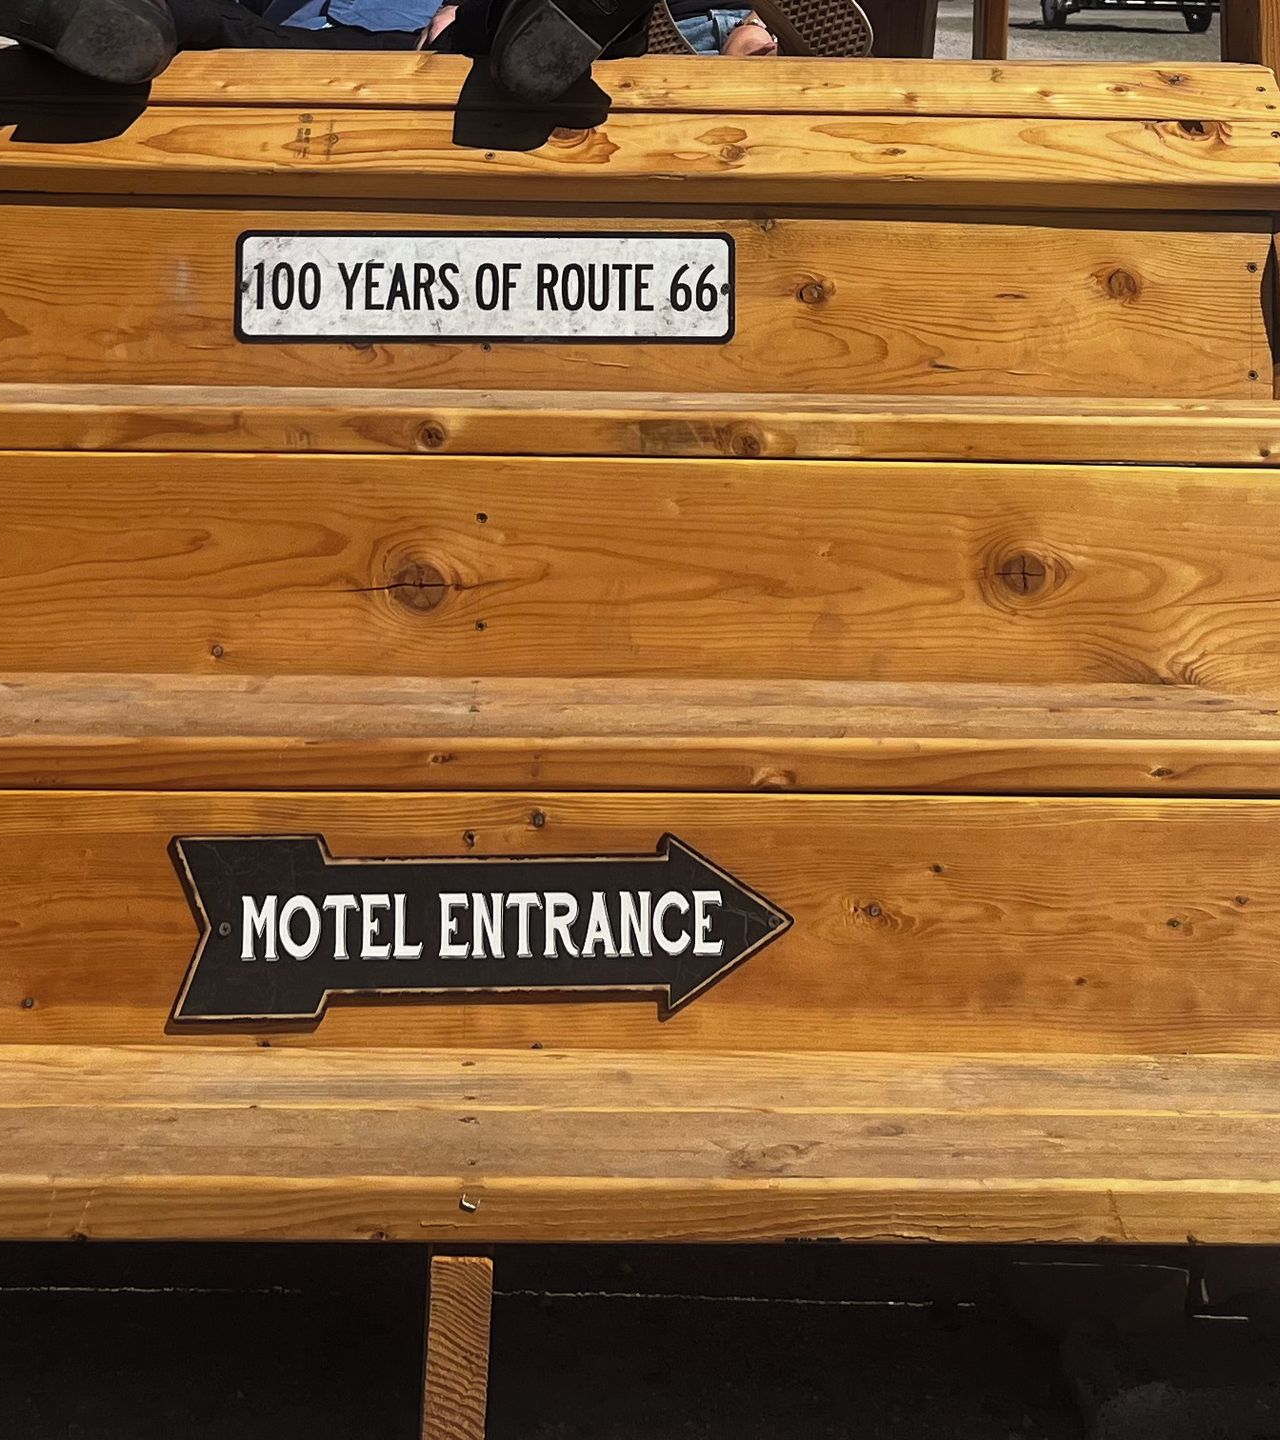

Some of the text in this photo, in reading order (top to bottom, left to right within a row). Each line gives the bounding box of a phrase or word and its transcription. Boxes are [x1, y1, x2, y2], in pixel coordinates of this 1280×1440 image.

[253, 261, 720, 312] 100 YEARS OF ROUTE 66
[239, 890, 727, 961] MOTEL ENTRANCE
